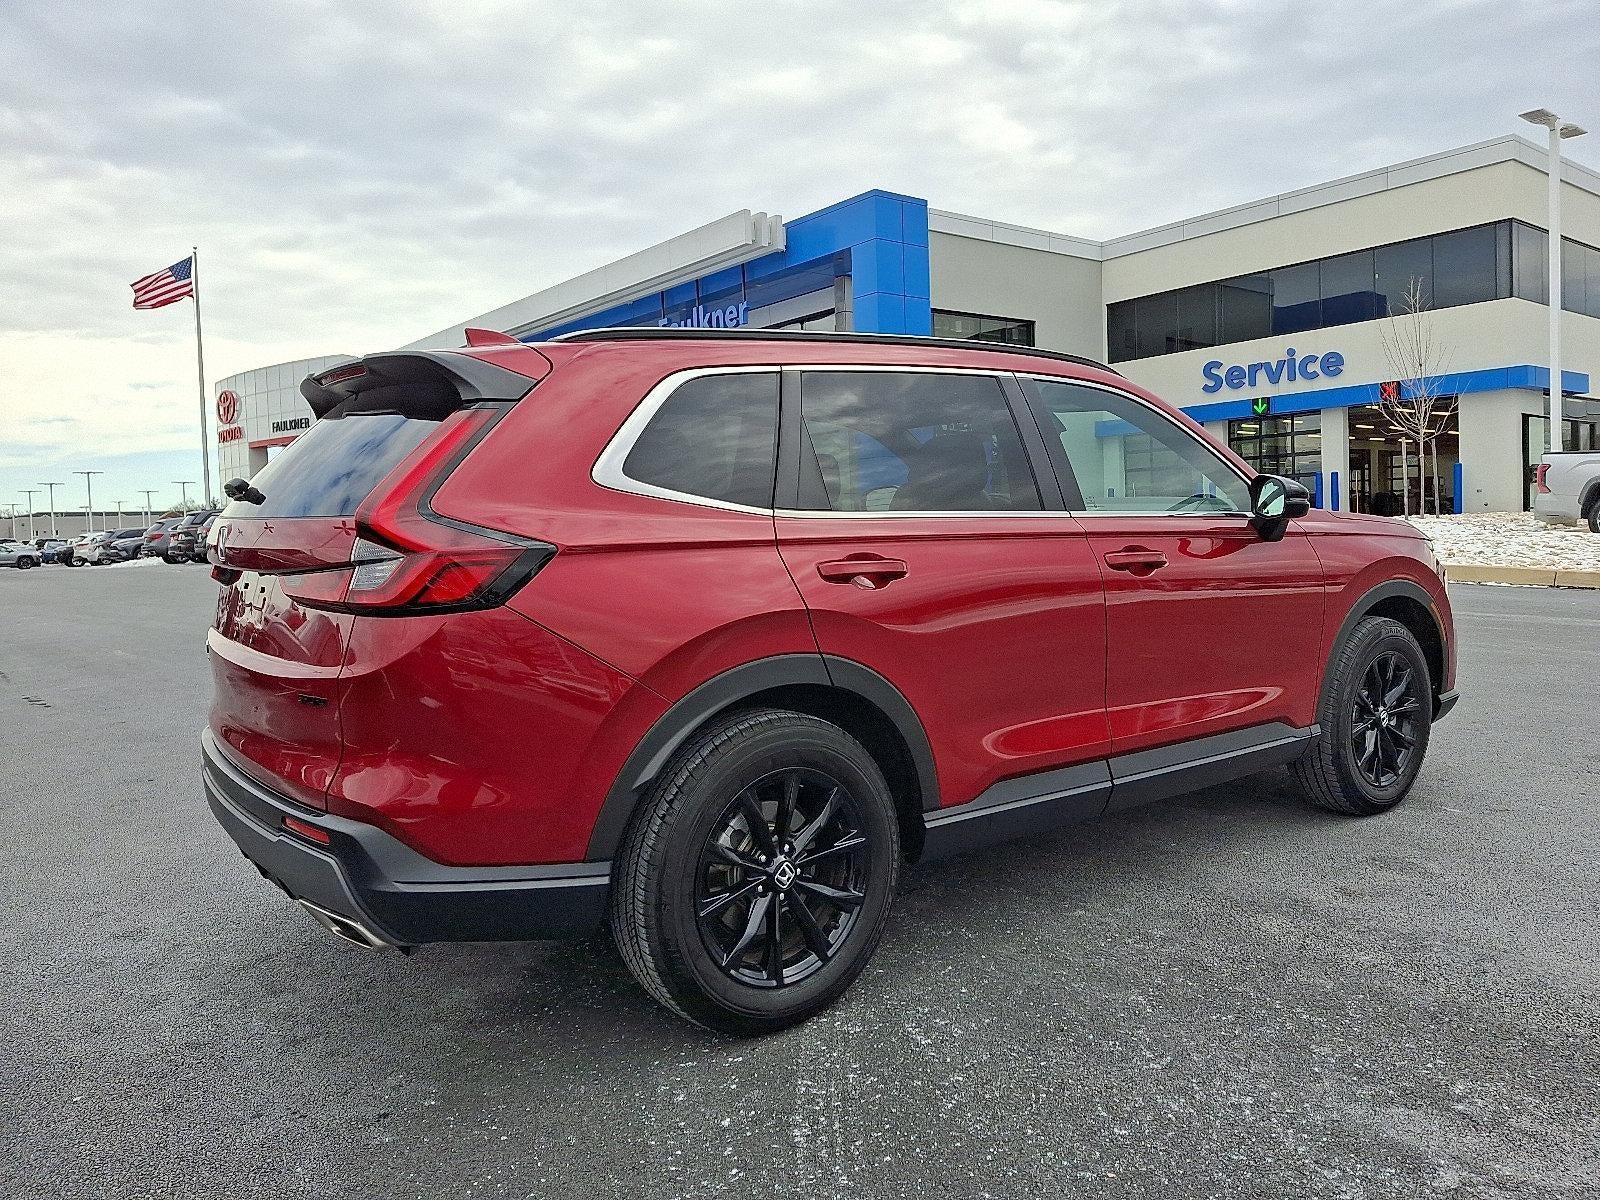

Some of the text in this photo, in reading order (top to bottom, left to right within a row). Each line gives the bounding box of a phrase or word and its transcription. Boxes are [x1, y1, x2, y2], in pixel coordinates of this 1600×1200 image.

[1201, 347, 1345, 394] Service
[272, 417, 310, 433] FAULKNER
[218, 426, 243, 444] TOYOTA
